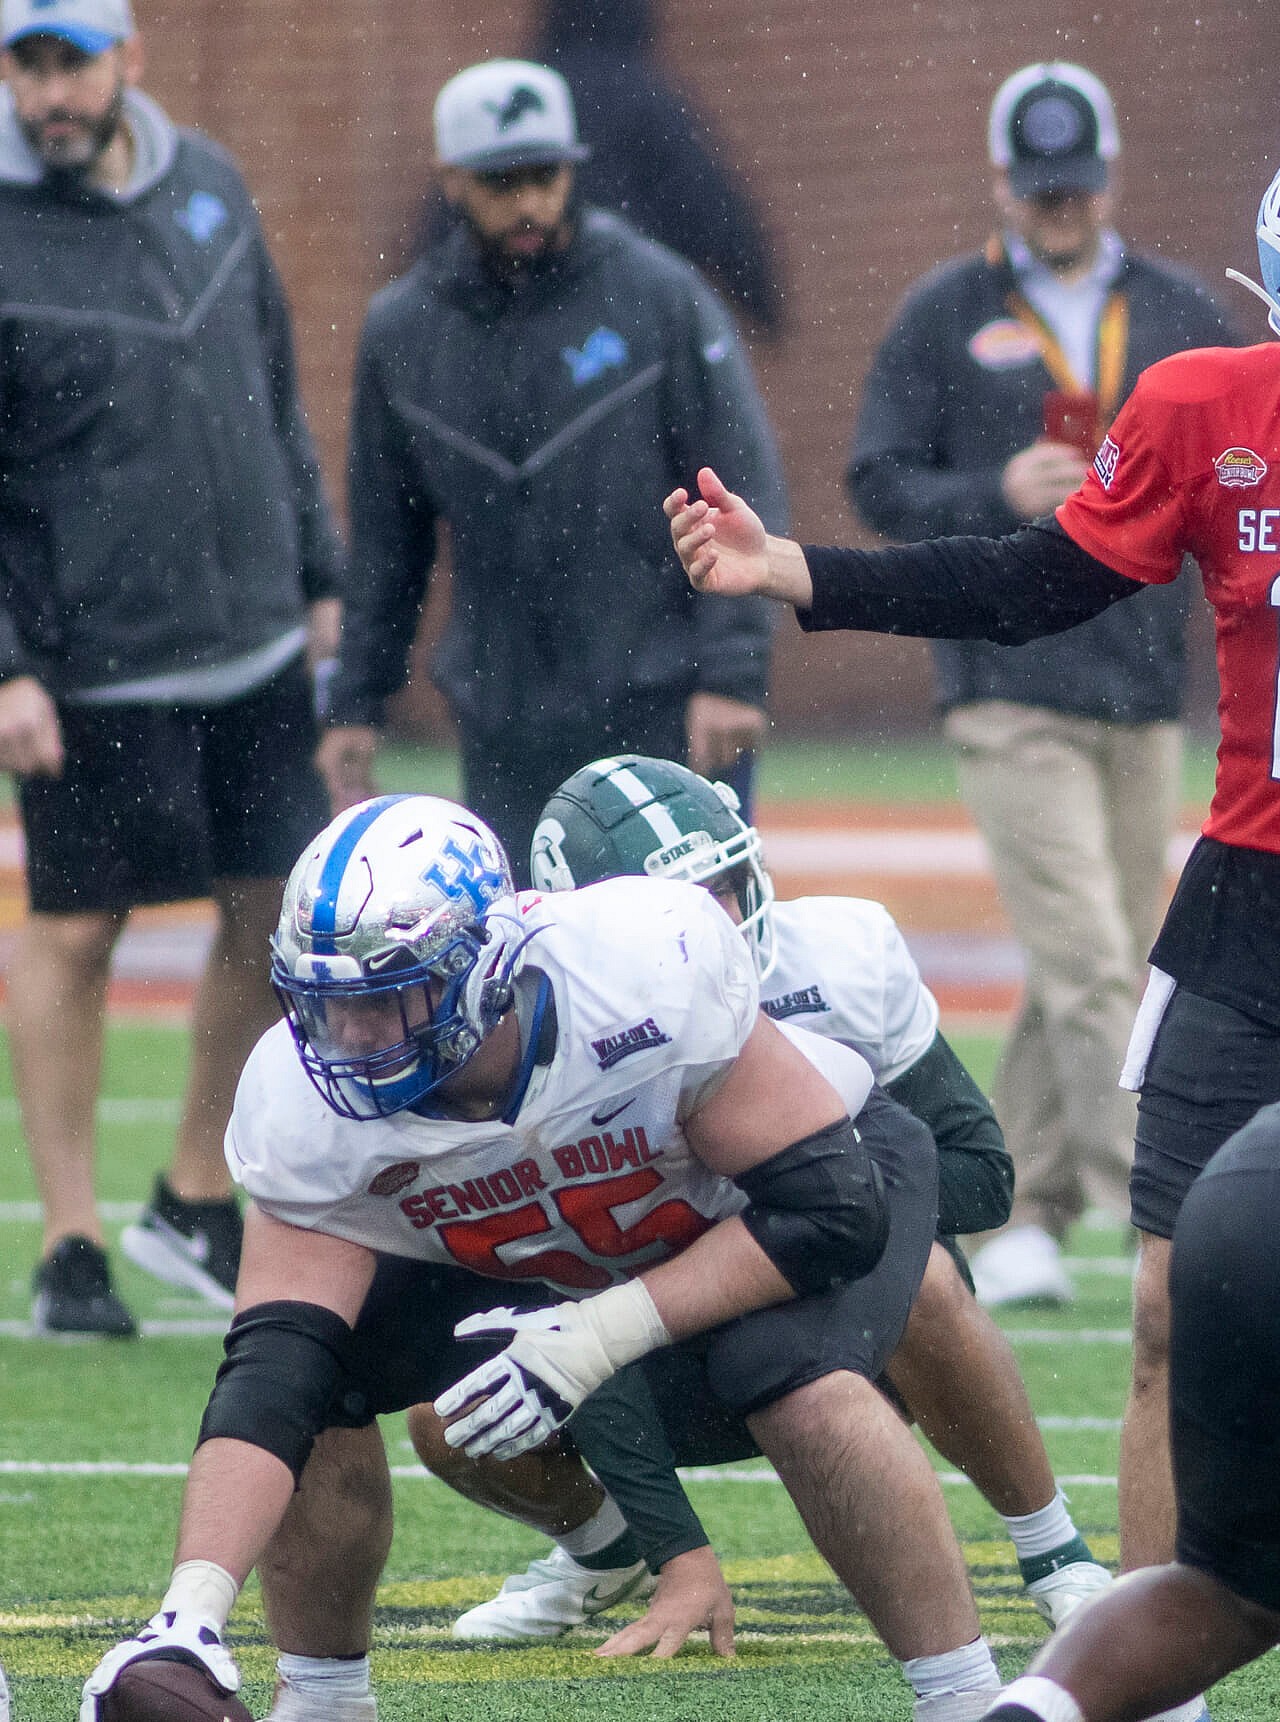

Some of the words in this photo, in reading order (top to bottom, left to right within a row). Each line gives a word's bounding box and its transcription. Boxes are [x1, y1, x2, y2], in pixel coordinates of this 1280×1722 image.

[660, 839, 695, 865] STATE
[591, 1017, 661, 1061] WALK-ON'S
[400, 1158, 549, 1230] SENIOR
[552, 1126, 665, 1179] BOWL
[435, 1165, 722, 1291] 55
